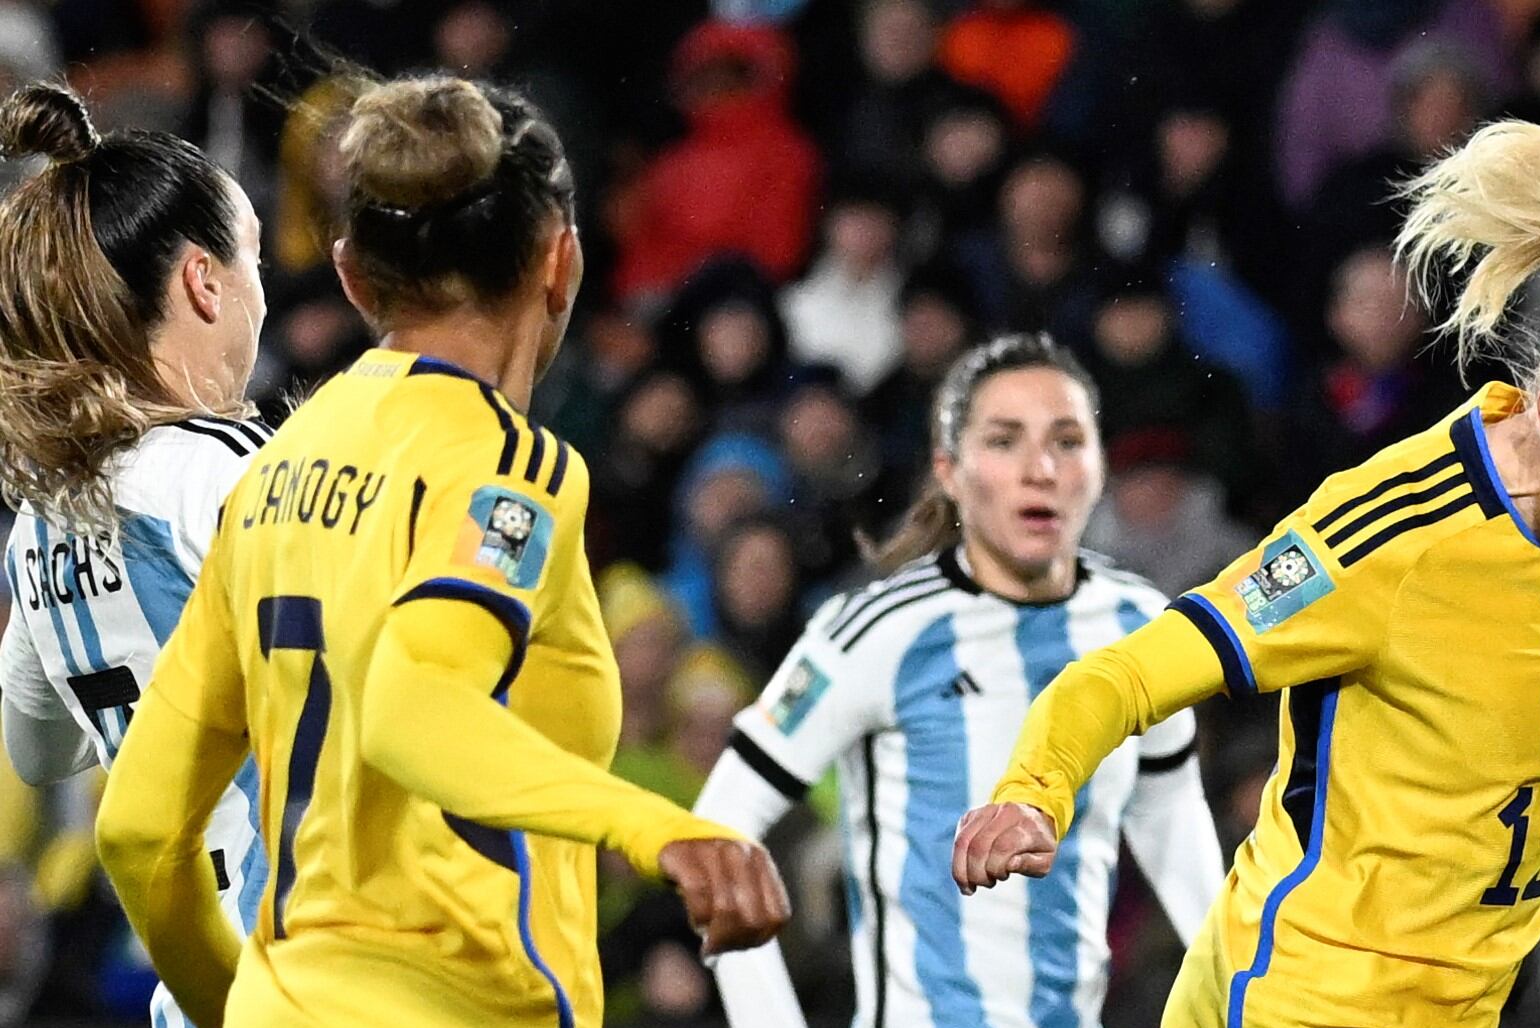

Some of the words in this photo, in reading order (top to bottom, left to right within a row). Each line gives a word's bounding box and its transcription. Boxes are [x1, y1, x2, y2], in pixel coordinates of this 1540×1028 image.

[243, 456, 386, 536] JANOGY
[25, 529, 123, 612] SACHS
[256, 594, 333, 941] 7
